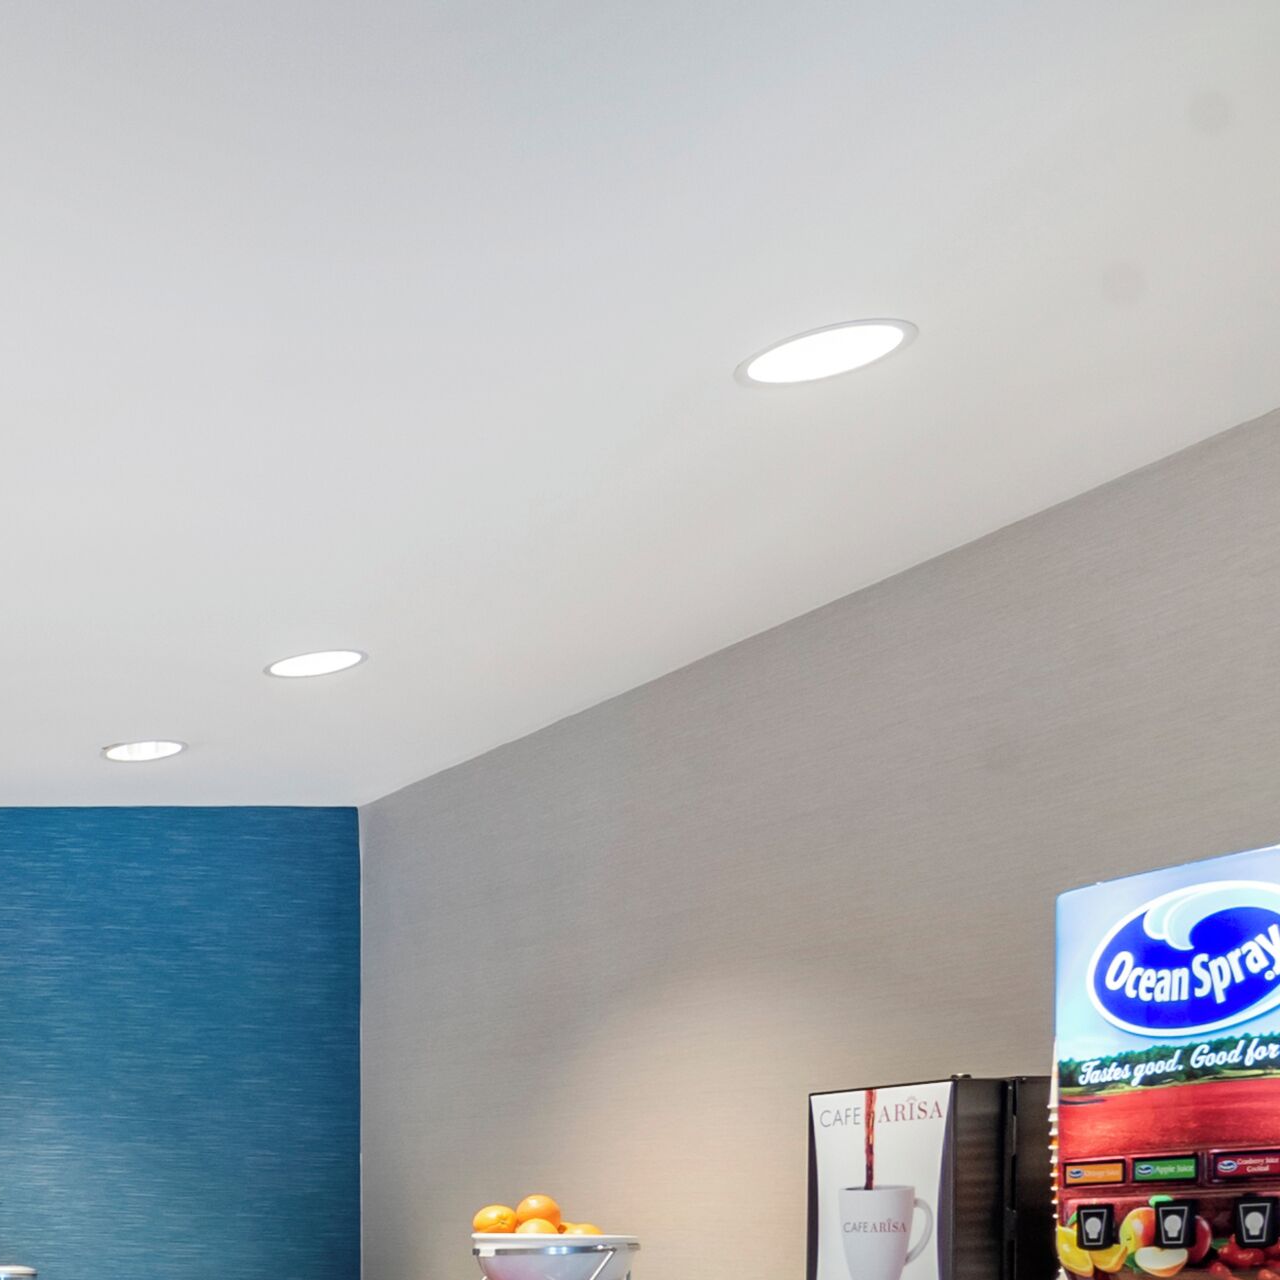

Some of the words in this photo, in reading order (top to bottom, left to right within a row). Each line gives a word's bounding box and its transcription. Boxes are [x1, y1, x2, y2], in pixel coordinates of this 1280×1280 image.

[1105, 951, 1188, 1003] Ocean
[1078, 1061, 1131, 1086] Tastes
[1133, 1050, 1184, 1086] good.
[1190, 1040, 1243, 1068] Good
[1243, 1037, 1280, 1067] for
[820, 1107, 862, 1128] CAFE
[1154, 1165, 1176, 1175] Apple
[843, 1221, 868, 1233] CAFE
